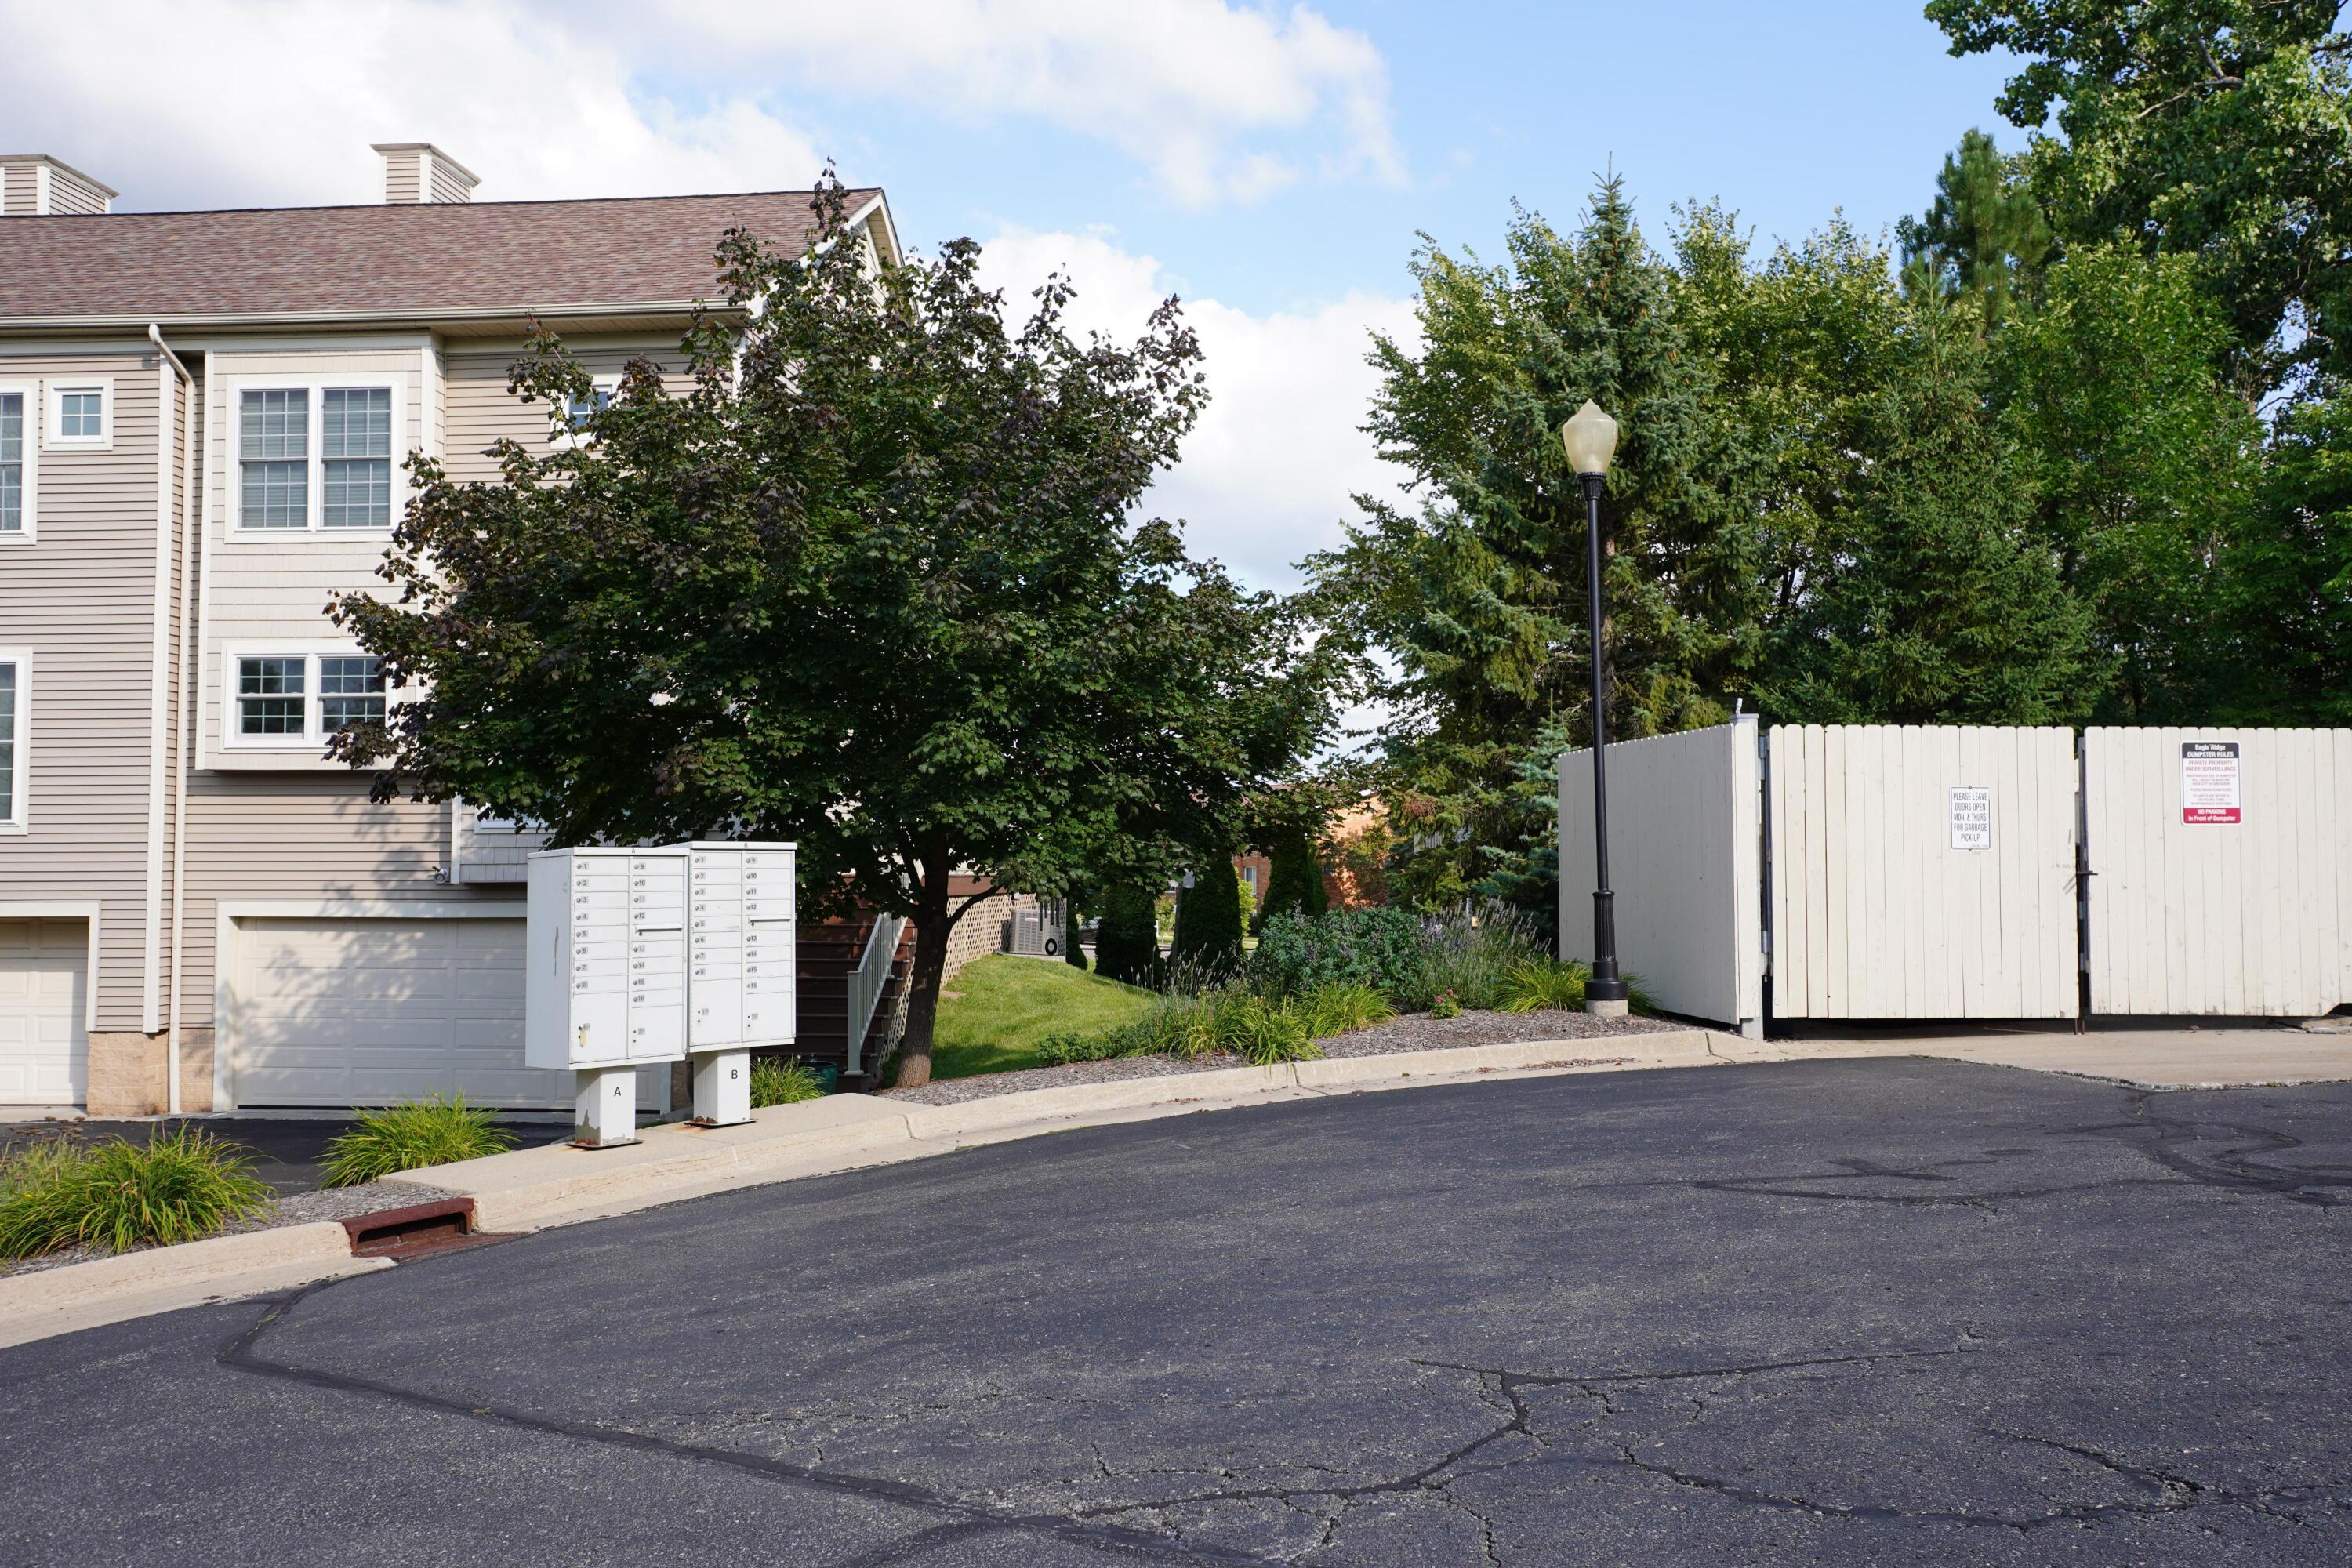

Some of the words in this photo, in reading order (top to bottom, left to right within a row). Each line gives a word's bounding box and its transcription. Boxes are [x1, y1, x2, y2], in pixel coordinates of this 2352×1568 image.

[1953, 792, 1971, 800] PLEASE
[1973, 792, 1987, 801] LEAVE
[1955, 802, 1972, 811] DOORS
[1973, 802, 1986, 811] OPEN
[1972, 813, 1988, 822] THURS.
[1965, 823, 1987, 832] GARBAGE
[731, 1069, 739, 1080] B
[614, 1087, 622, 1097] A
